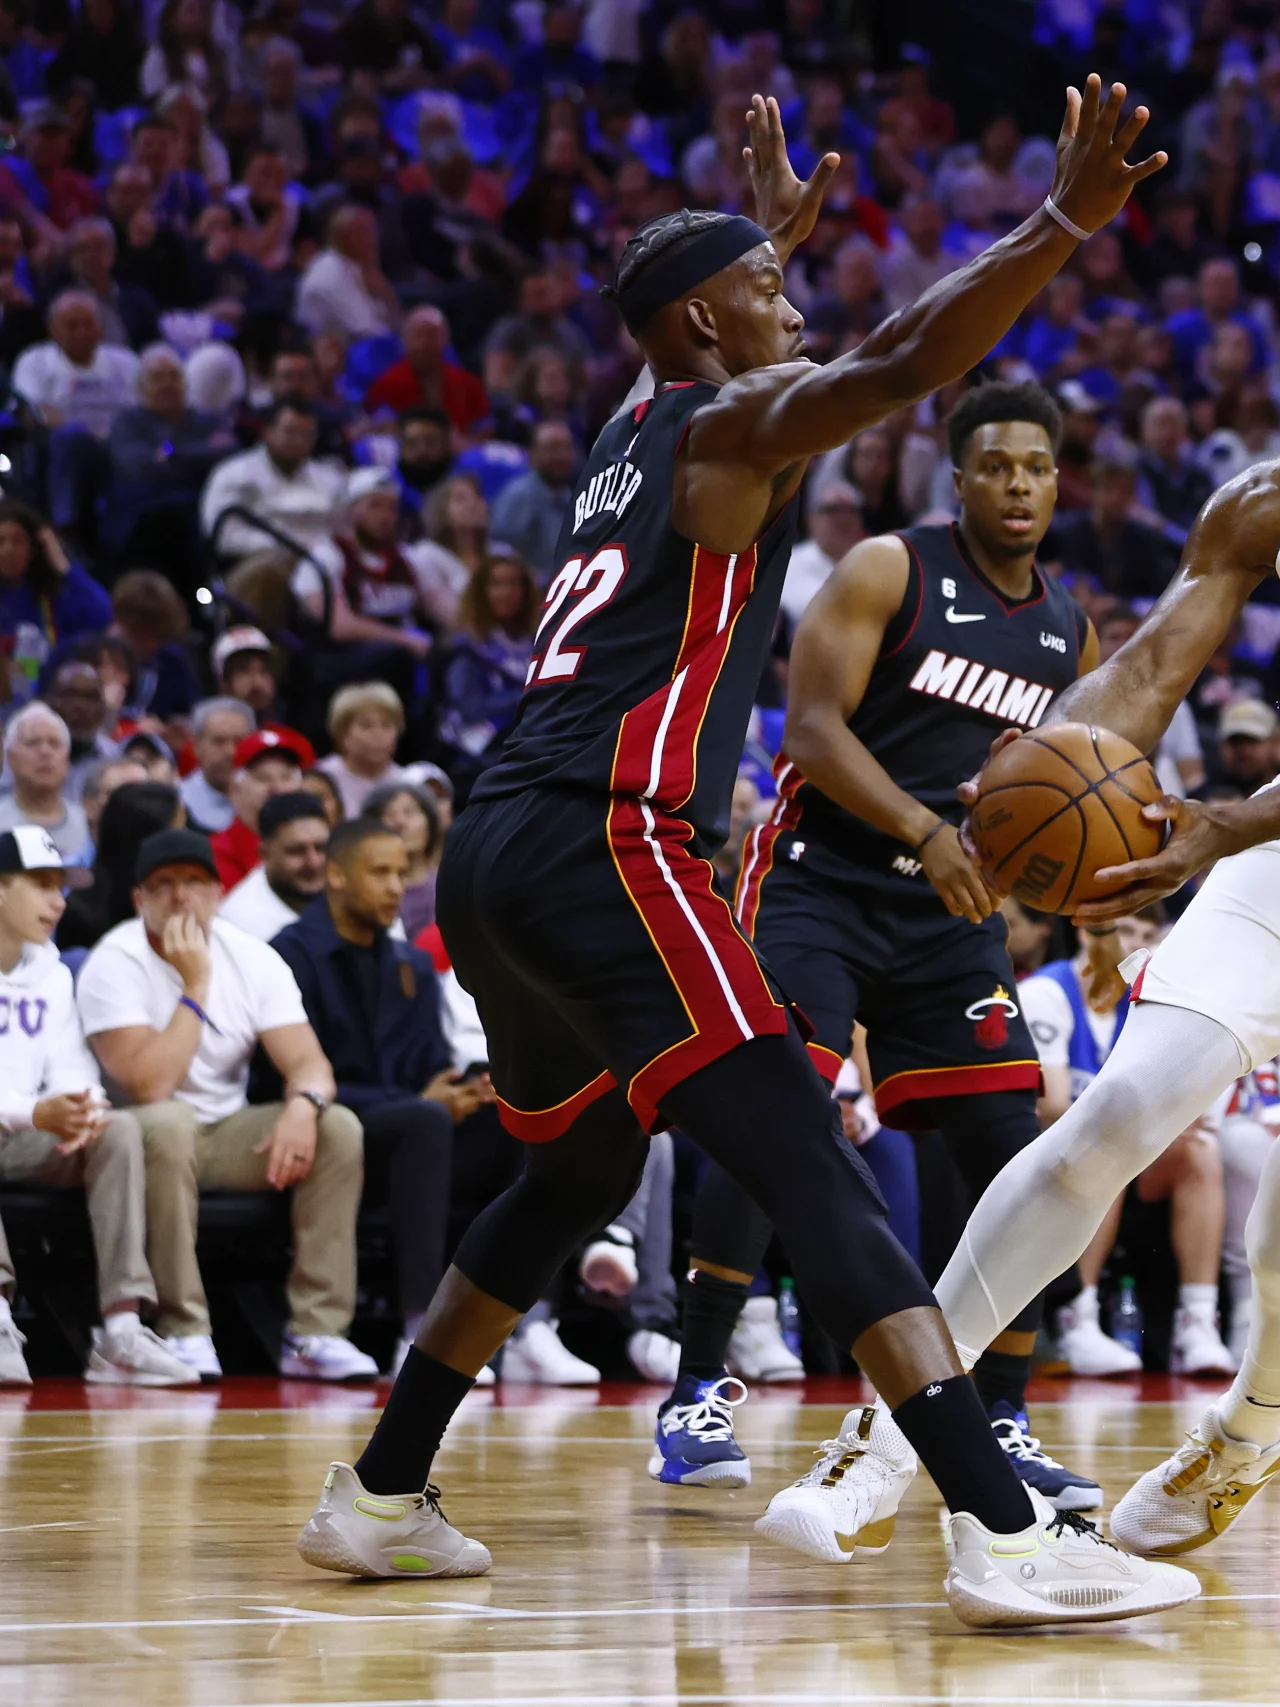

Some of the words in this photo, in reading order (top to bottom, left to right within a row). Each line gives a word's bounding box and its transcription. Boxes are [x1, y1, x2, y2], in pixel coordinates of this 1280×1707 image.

[572, 461, 643, 535] BUTLER
[524, 543, 629, 689] 22
[942, 578, 956, 599] 6
[909, 650, 1054, 728] MIAMI
